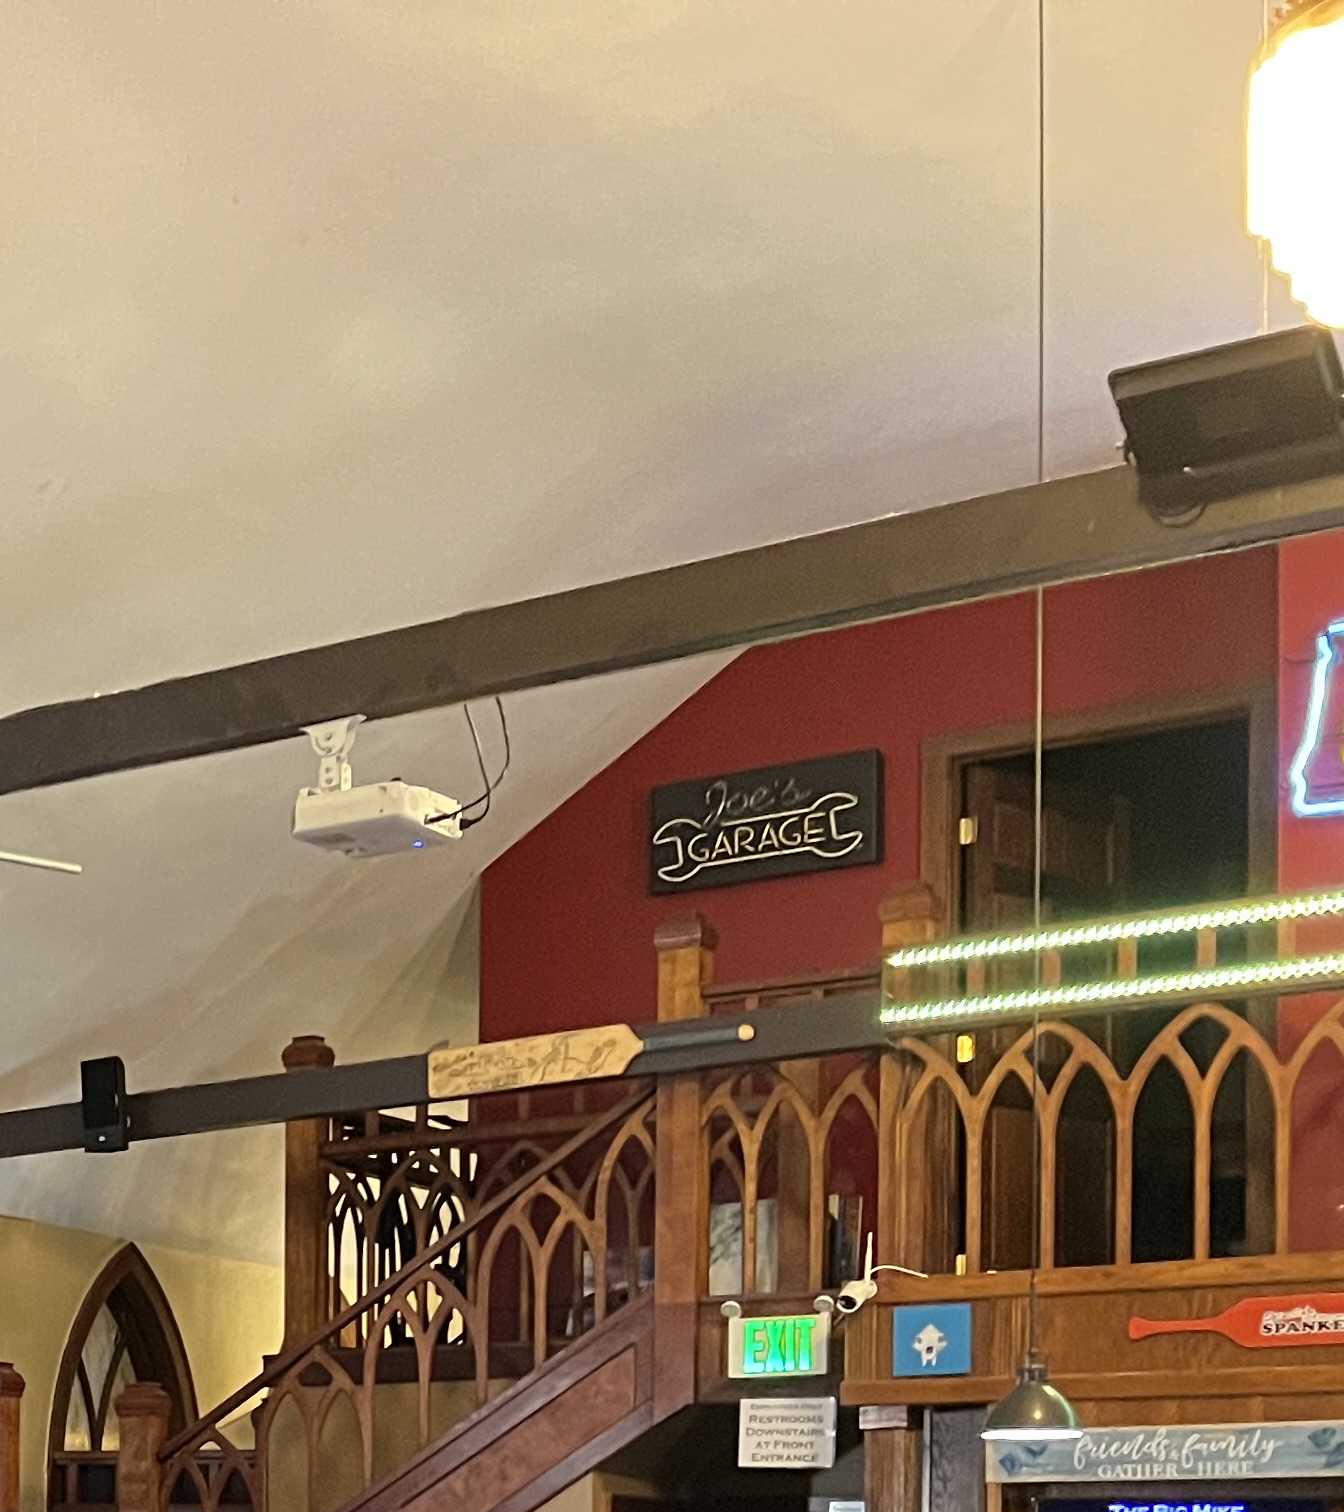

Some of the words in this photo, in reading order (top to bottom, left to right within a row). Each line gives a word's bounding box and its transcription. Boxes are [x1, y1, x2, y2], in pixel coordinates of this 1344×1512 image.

[702, 778, 812, 830] Joe's
[687, 811, 827, 862] GARAGE
[743, 1318, 816, 1374] EXIT
[1074, 1428, 1167, 1470] friends
[1181, 1429, 1282, 1468] family
[1097, 1462, 1178, 1478] GATHER
[1198, 1461, 1254, 1476] HERE
